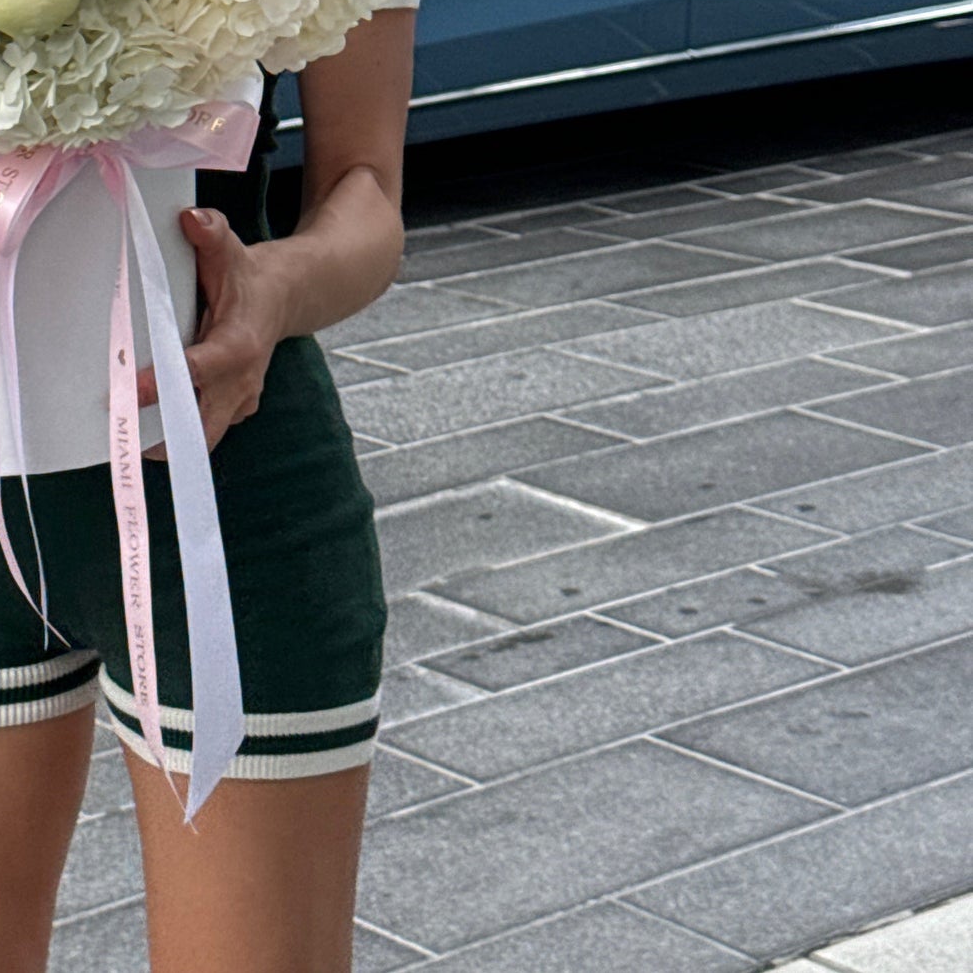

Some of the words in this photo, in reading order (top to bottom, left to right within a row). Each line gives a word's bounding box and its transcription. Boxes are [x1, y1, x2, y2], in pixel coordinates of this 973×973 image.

[117, 417, 134, 489] MIAMI
[124, 505, 141, 610] FLOWER
[133, 624, 150, 707] STORE
